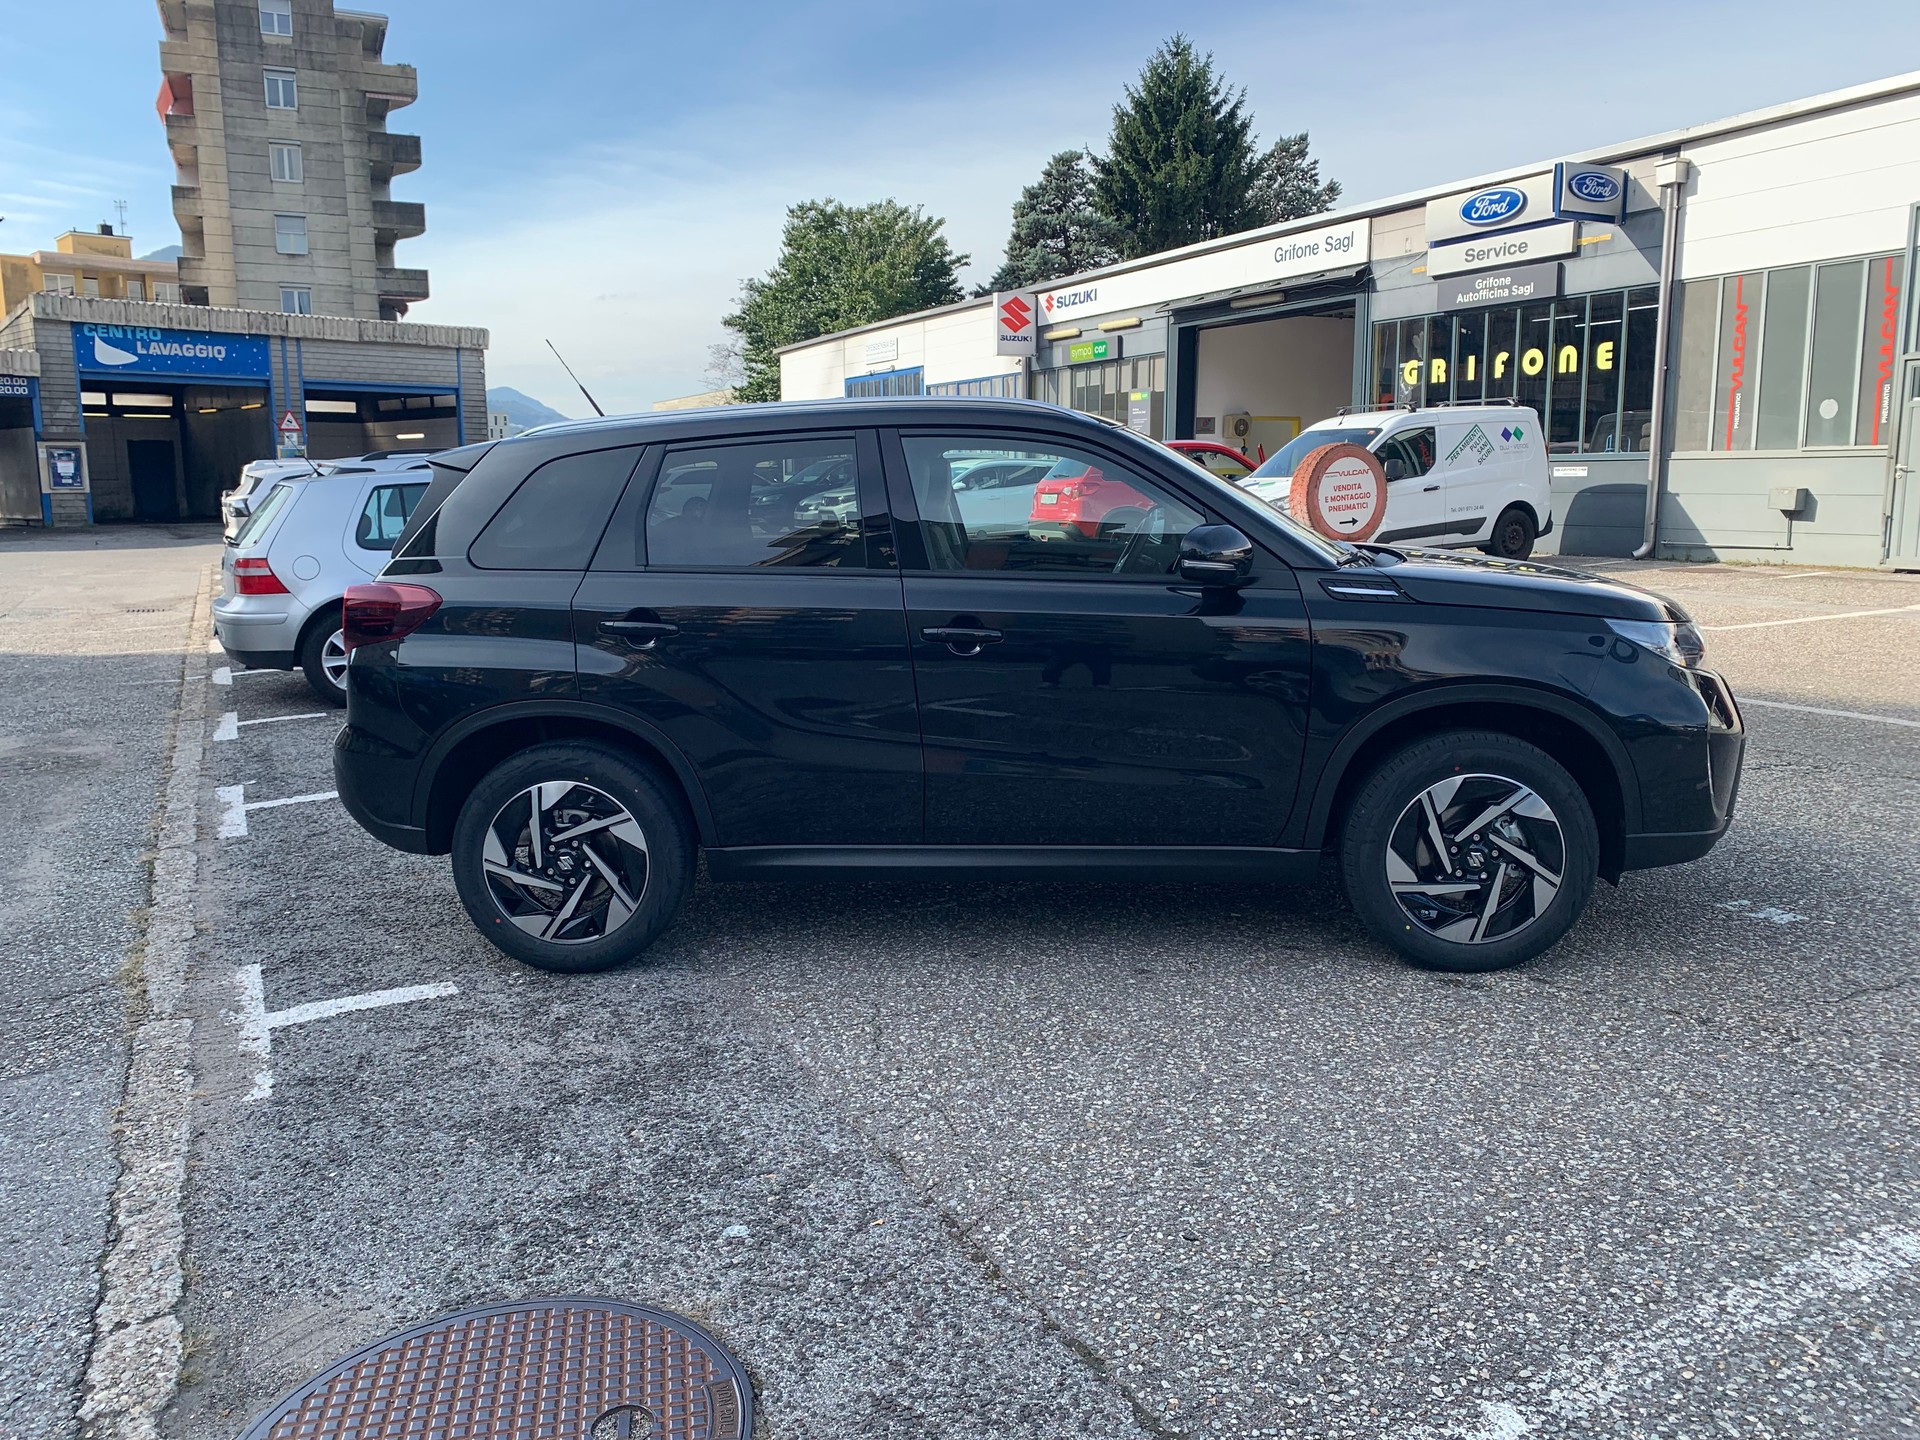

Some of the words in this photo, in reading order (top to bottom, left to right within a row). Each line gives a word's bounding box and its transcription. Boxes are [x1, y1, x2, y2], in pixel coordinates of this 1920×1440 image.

[1274, 243, 1320, 263] Grifone
[1325, 230, 1354, 253] Sagl
[1464, 241, 1529, 263] Service
[1475, 276, 1512, 290] Grifone
[1056, 288, 1098, 309] SUZUKI
[1456, 286, 1509, 303] Autofficina
[1511, 282, 1534, 296] Sagl
[83, 323, 161, 341] CENTRO
[136, 341, 226, 359] LAVAGGIO
[1071, 346, 1092, 359] sympa
[1094, 344, 1106, 354] car
[1403, 341, 1614, 385] GRIFONE
[1733, 393, 1742, 429] PNEUMATICI
[1881, 383, 1891, 423] PNEUMATICI
[1469, 434, 1486, 452] PULITI
[1477, 440, 1489, 455] SANI
[1477, 446, 1493, 466] SICURI
[1338, 468, 1370, 477] VULCAN
[1333, 482, 1362, 492] VENDITA
[1330, 491, 1371, 503] MONTAGGIO
[1328, 502, 1369, 513] PNEUMATICI
